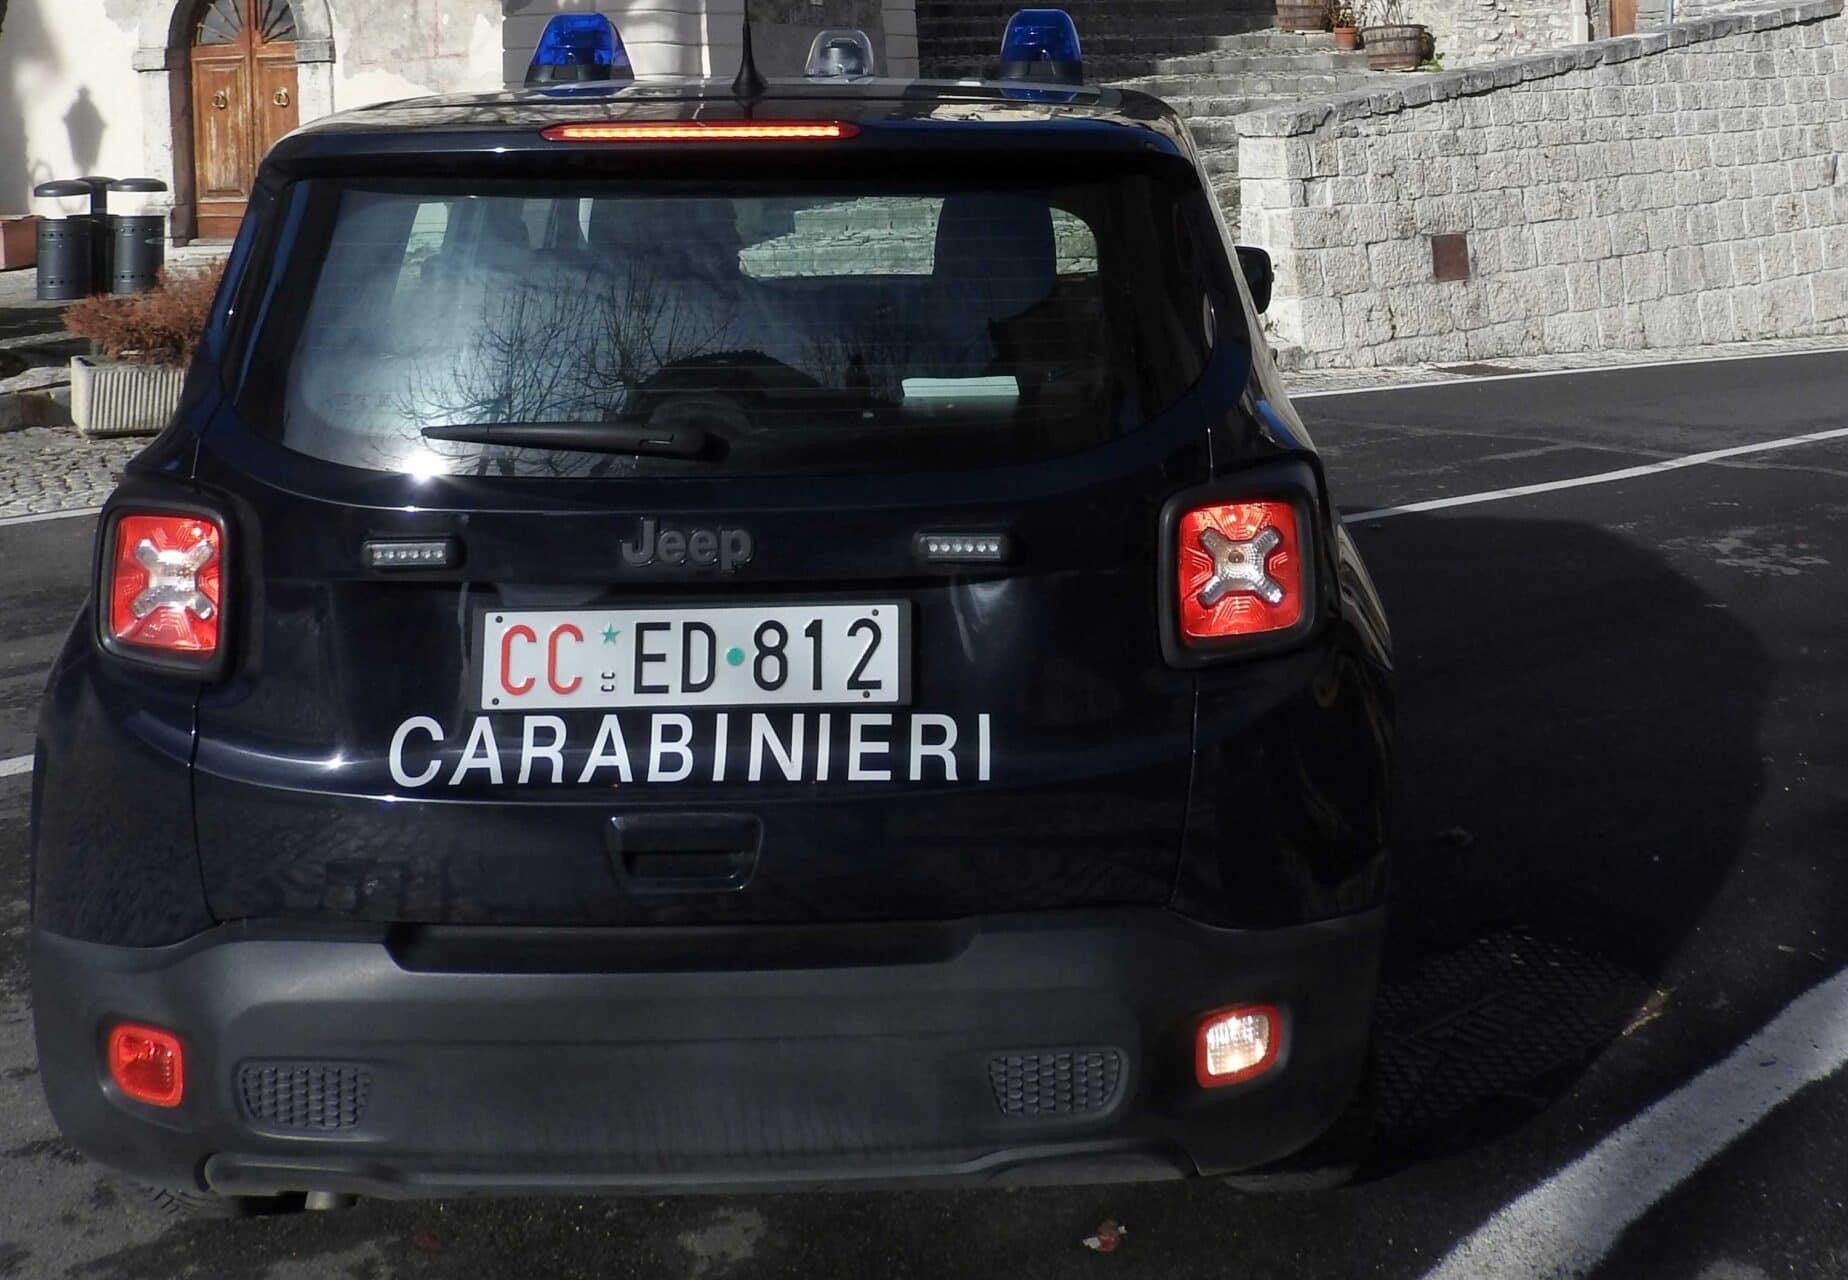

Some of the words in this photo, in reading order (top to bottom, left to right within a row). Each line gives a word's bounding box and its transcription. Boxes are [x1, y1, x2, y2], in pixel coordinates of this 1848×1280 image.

[621, 519, 753, 574] Jeep
[500, 623, 583, 696] CC
[388, 713, 991, 788] CARABINIERI
